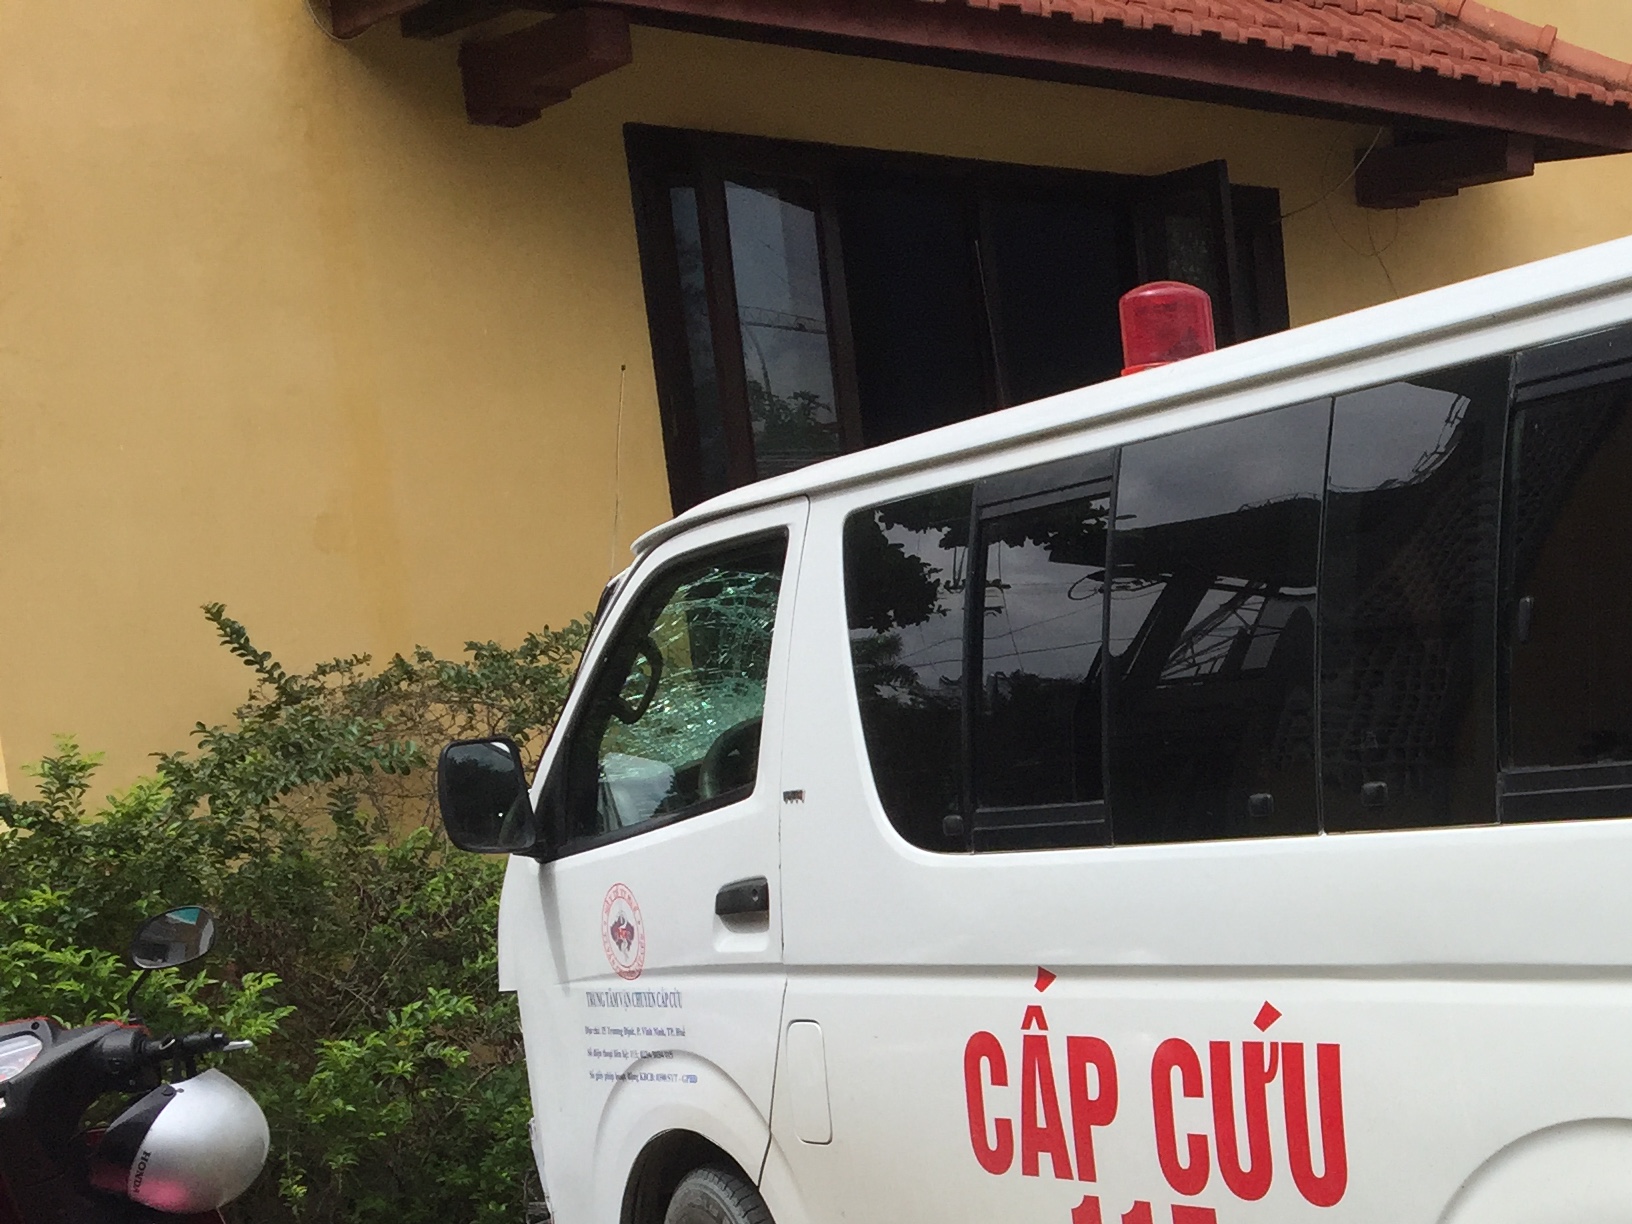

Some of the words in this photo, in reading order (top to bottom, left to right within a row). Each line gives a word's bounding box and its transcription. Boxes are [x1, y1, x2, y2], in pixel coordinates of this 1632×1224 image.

[964, 966, 1119, 1182] CẤP
[1151, 1000, 1348, 1207] CỨU
[133, 1151, 151, 1194] HONDA
